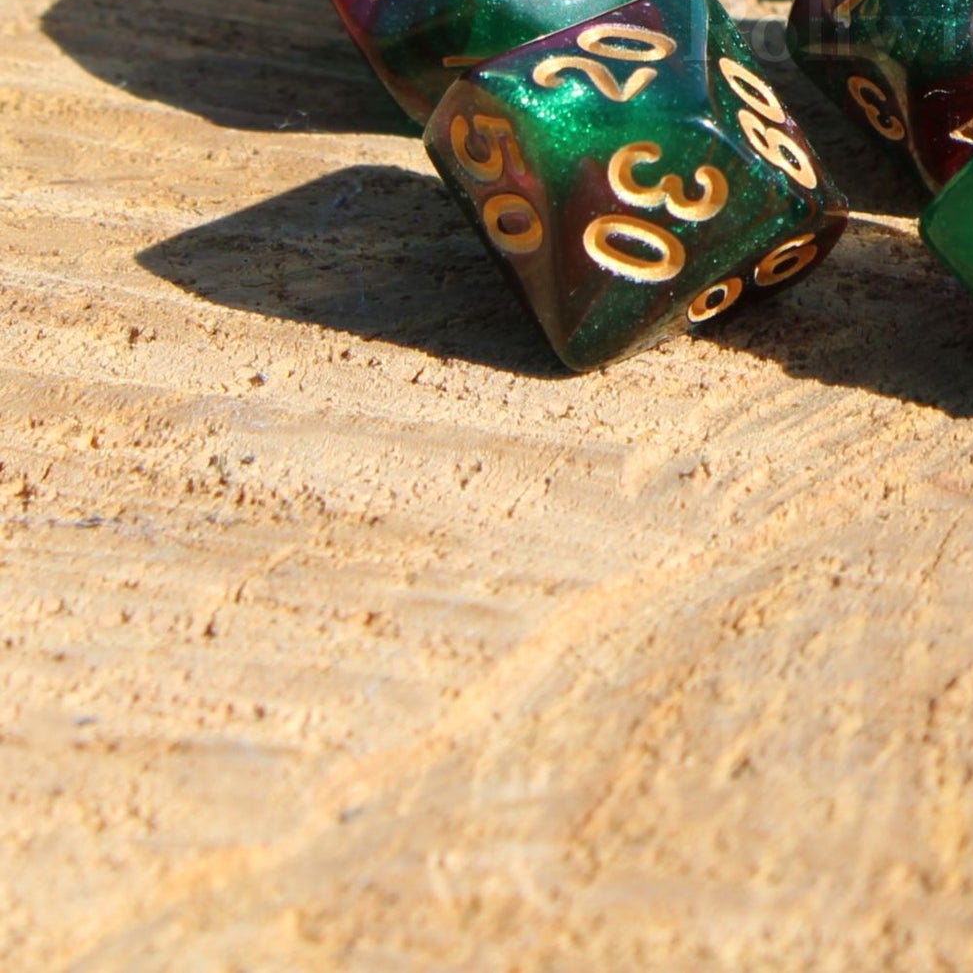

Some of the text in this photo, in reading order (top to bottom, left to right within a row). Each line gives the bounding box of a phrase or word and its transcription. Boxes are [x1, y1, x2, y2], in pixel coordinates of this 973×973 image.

[532, 23, 677, 101] 20
[718, 57, 817, 189] 80
[848, 76, 905, 141] 3
[451, 114, 543, 254] 50
[583, 140, 728, 283] 30
